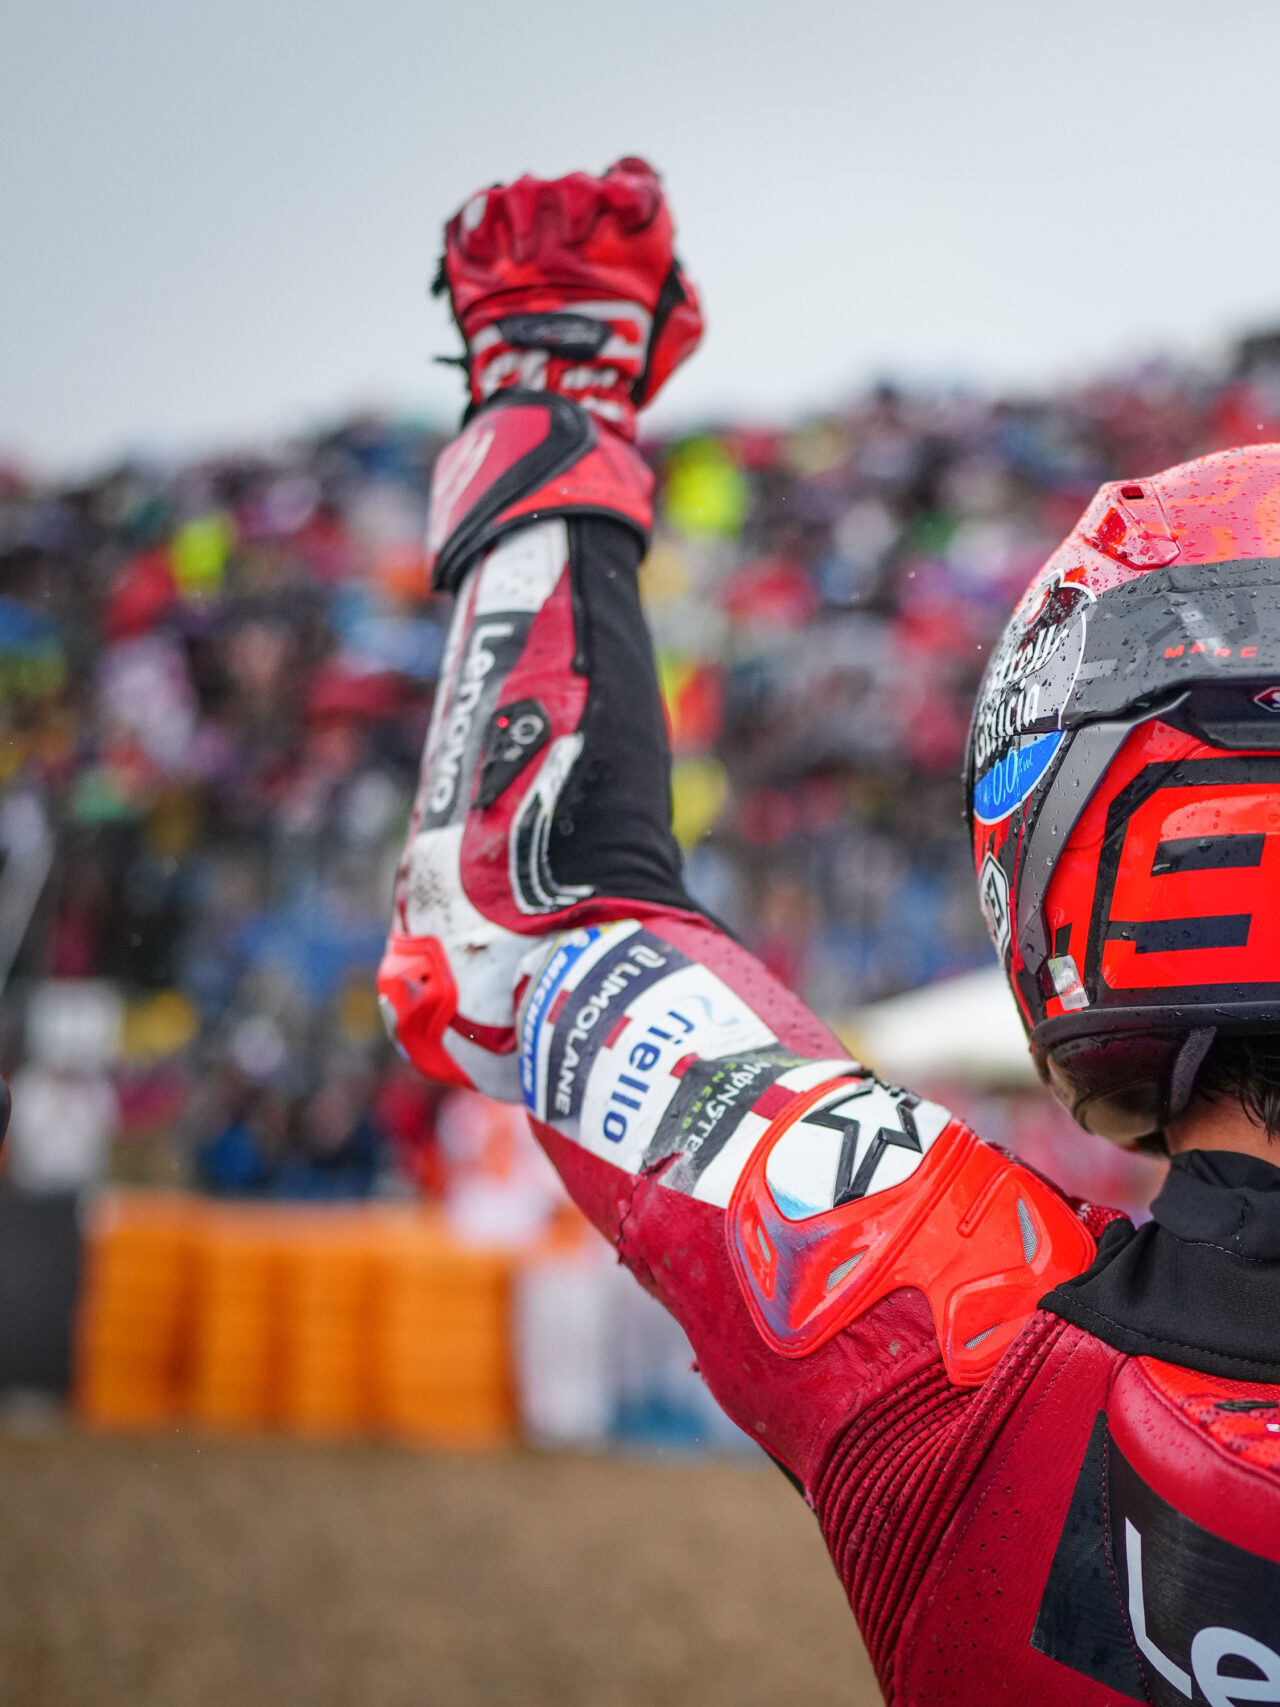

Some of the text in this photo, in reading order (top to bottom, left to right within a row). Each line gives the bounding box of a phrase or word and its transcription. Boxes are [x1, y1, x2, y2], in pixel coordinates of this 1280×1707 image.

[430, 622, 515, 813] Lenovo
[1164, 641, 1258, 660] MARC
[520, 952, 571, 1092] MICHELIN
[602, 1010, 697, 1144] riello
[683, 1058, 773, 1157] MONSTE
